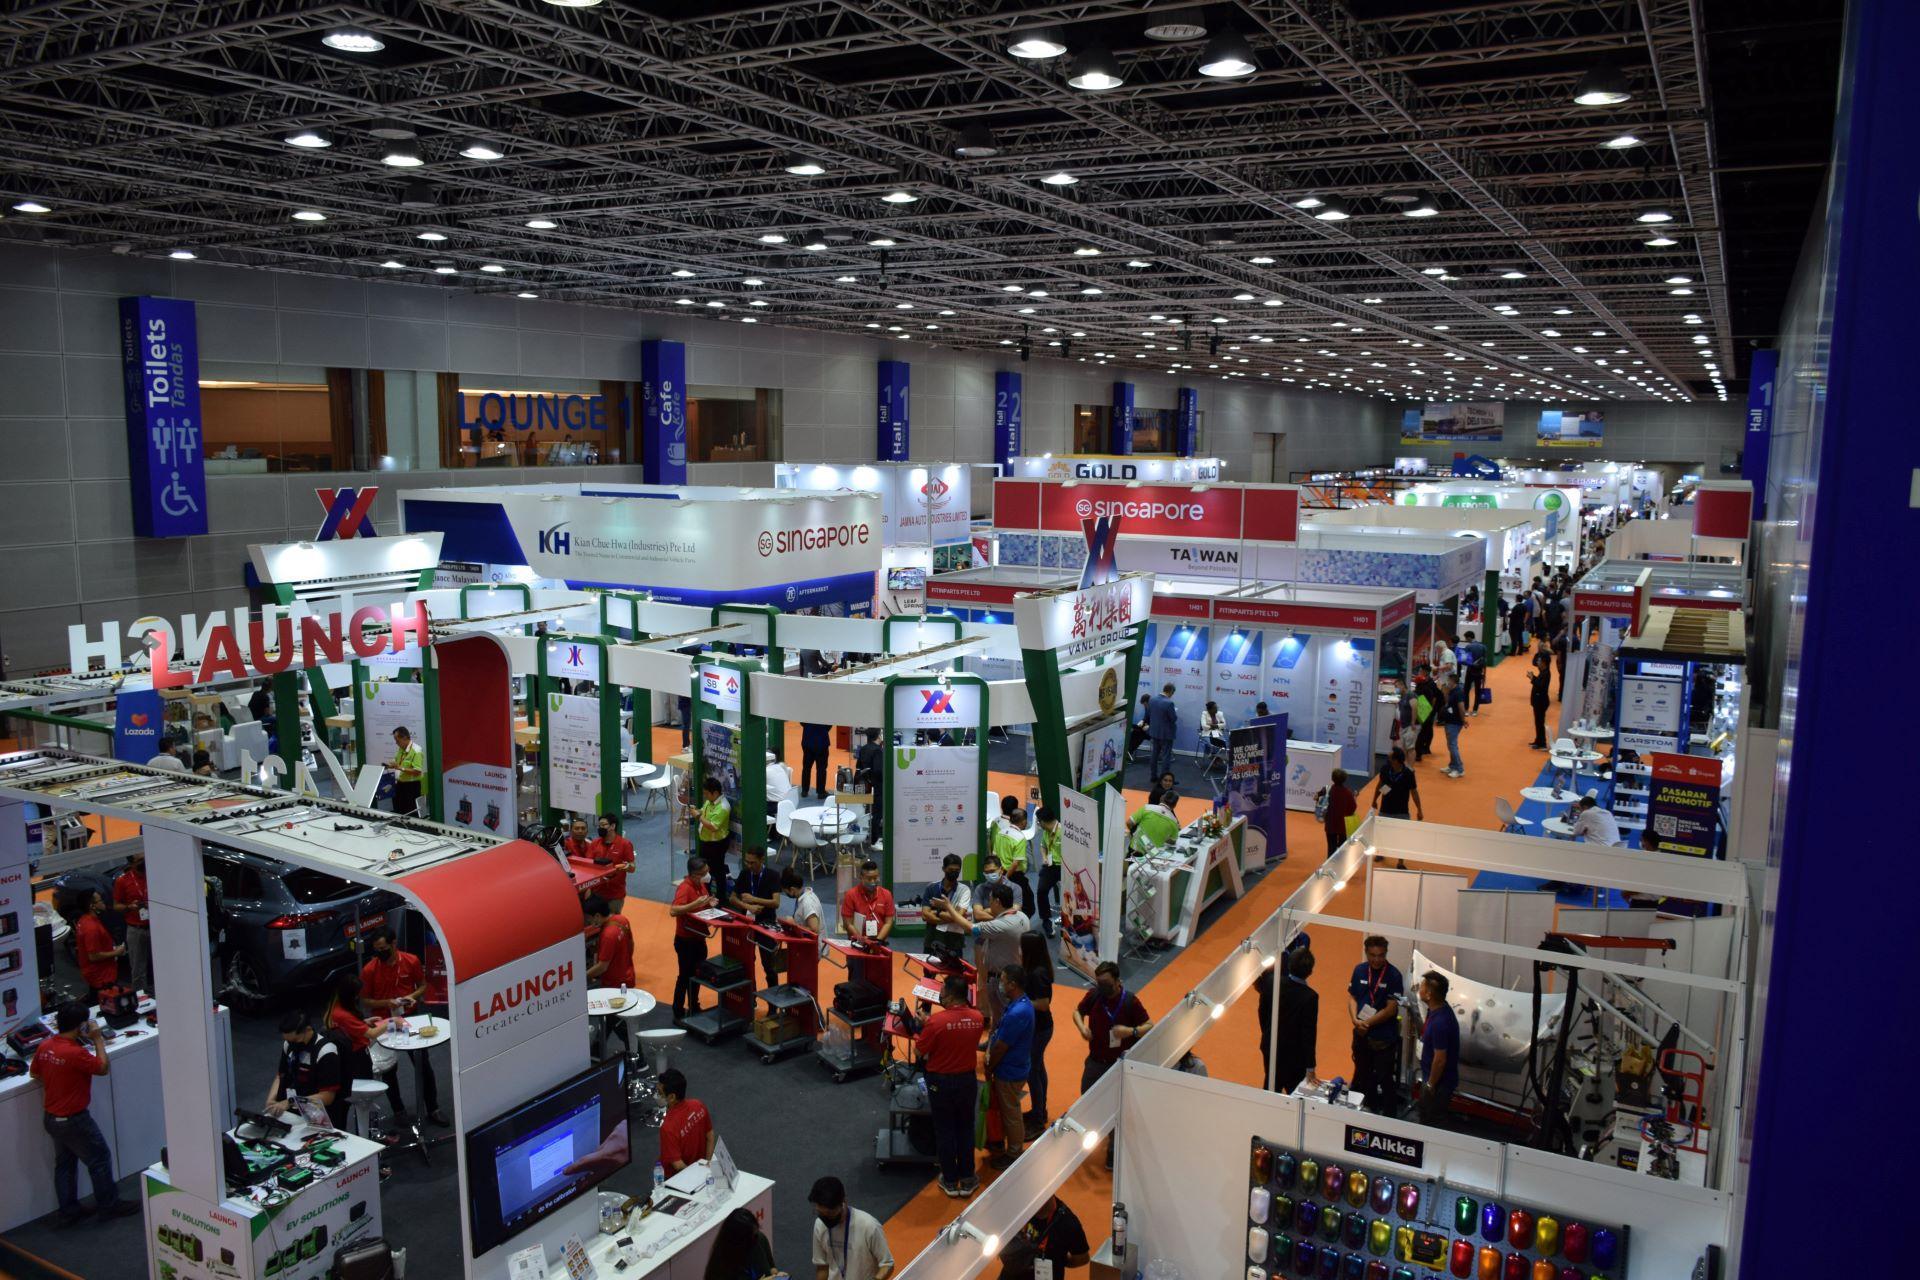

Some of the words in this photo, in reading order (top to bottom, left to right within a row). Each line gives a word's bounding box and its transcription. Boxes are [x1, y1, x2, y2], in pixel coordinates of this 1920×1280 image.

[145, 318, 166, 408] Toilets
[170, 343, 184, 408] Tandas
[884, 385, 892, 404] 1
[998, 391, 1008, 408] 2
[660, 380, 673, 426] Cafe
[671, 391, 682, 426] Kafe
[1011, 392, 1021, 423] 2
[1750, 409, 1762, 432] Hall
[1759, 381, 1773, 406] 1
[458, 391, 608, 432] LOUNGE
[893, 422, 901, 455] Hall
[900, 386, 909, 421] 1
[1075, 463, 1137, 480] GOLD
[574, 536, 591, 547] Kian
[611, 538, 628, 550] Hwa
[670, 542, 682, 553] Pte
[683, 542, 695, 554] Ltd
[799, 585, 829, 596] AFTERMARKET
[850, 601, 870, 611] WABCO
[1218, 607, 1253, 617] FITINPARTS
[1253, 610, 1266, 618] PTE
[1266, 611, 1279, 619] LTD
[1352, 615, 1370, 624] 1H01
[150, 600, 429, 690] LAUNCH
[1068, 639, 1097, 656] VANLI
[1100, 627, 1131, 646] GROUP
[706, 678, 718, 689] SB
[1272, 677, 1291, 685] NTN
[1272, 690, 1290, 698] NSK
[124, 727, 155, 736] Lazada
[1233, 746, 1245, 754] WE
[1244, 743, 1259, 752] OWE
[1623, 737, 1674, 747] CARSTOM
[1233, 751, 1247, 760] YOU
[1233, 758, 1250, 767] THAN
[484, 770, 507, 780] LAUNCH
[1231, 772, 1242, 781] AS
[1241, 769, 1260, 779] USUAL
[448, 777, 481, 788] MAINTENANCE
[481, 783, 508, 793] EQUIPMENT
[1662, 786, 1708, 800] PASARAN
[1655, 794, 1713, 808] AUTOMOTIF
[1064, 820, 1074, 831] Add
[1064, 831, 1074, 841] Add
[0, 873, 22, 885] NCH
[578, 877, 601, 891] LAUNCH
[360, 916, 384, 929] LAUNCH
[473, 960, 573, 1024] LAUNCH
[475, 989, 572, 1039] Create-Change
[1370, 1136, 1416, 1157] Aikka
[336, 1166, 371, 1189] LAUNCH
[209, 1210, 238, 1228] LAUNCH
[286, 1219, 300, 1232] EV
[300, 1191, 350, 1226] SOLUTIONS
[172, 1208, 181, 1219] EV
[182, 1213, 221, 1236] SOLUTIONS
